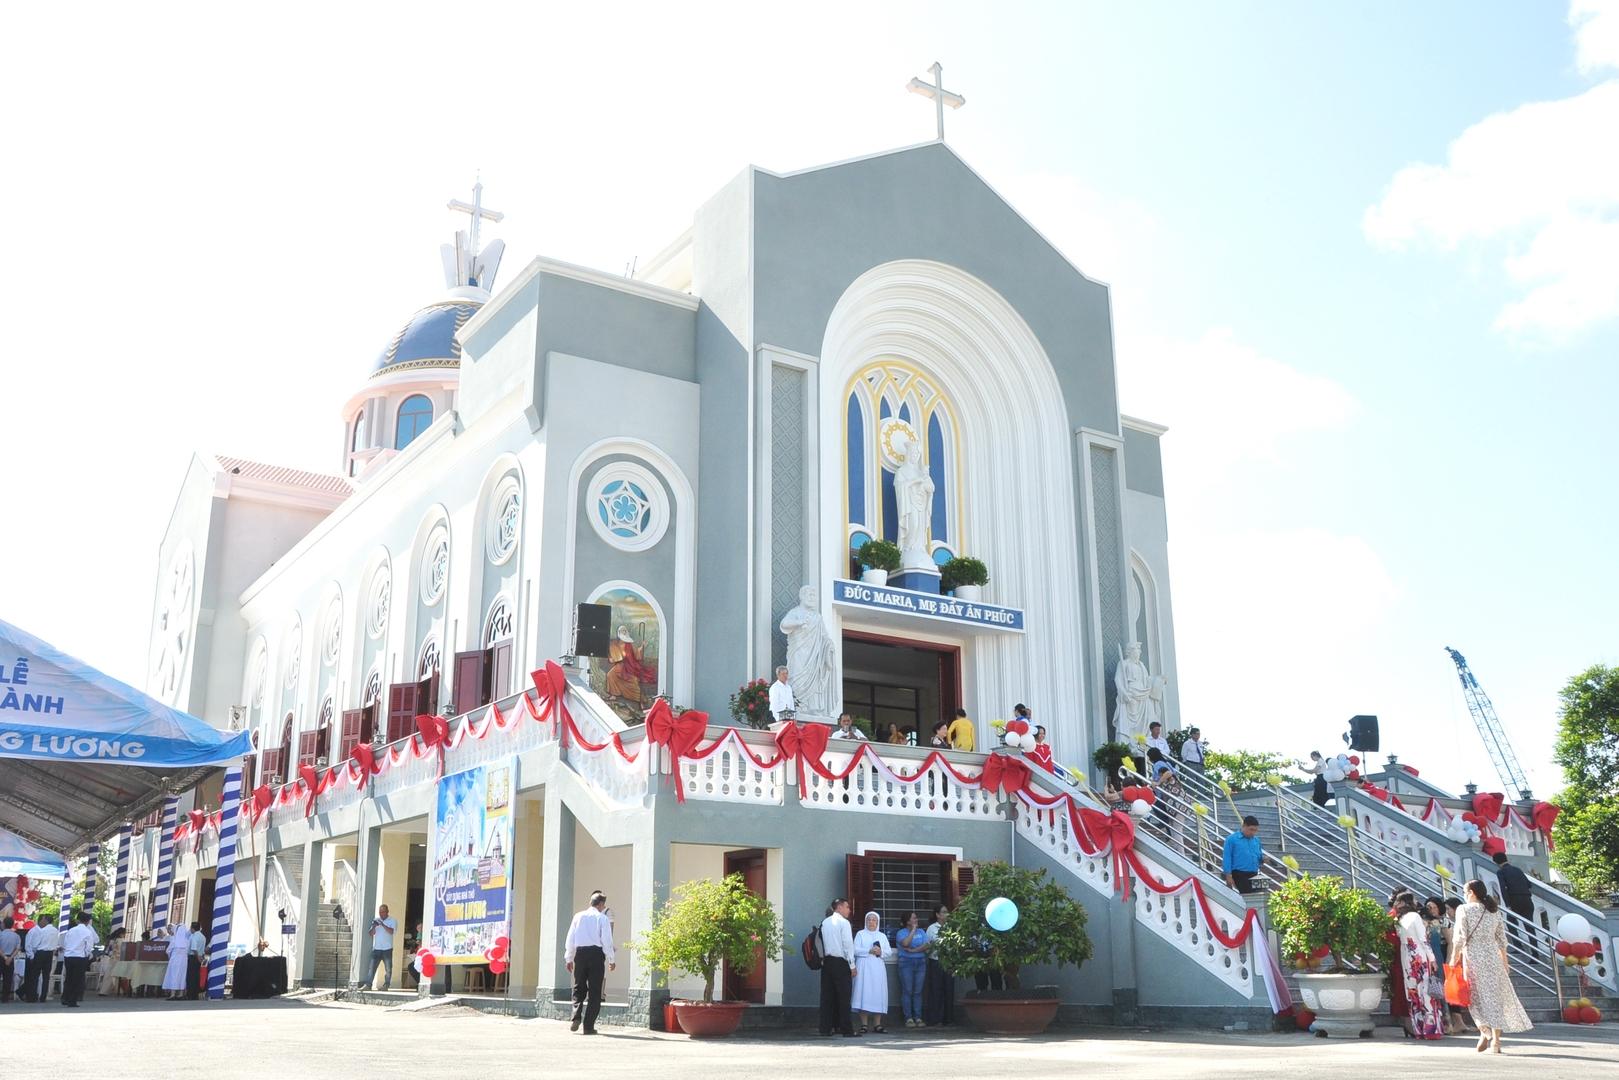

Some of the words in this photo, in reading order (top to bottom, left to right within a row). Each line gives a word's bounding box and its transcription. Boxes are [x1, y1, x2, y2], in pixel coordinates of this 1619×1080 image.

[844, 584, 871, 601] ĐỨC
[873, 591, 917, 611] MARIA,
[918, 599, 938, 615] MẸ
[965, 604, 982, 620] ÂN
[984, 609, 1015, 625] PHÚC
[0, 657, 29, 686] LỄ
[0, 686, 64, 714] ÀNH
[31, 735, 146, 758] LƯƠNG
